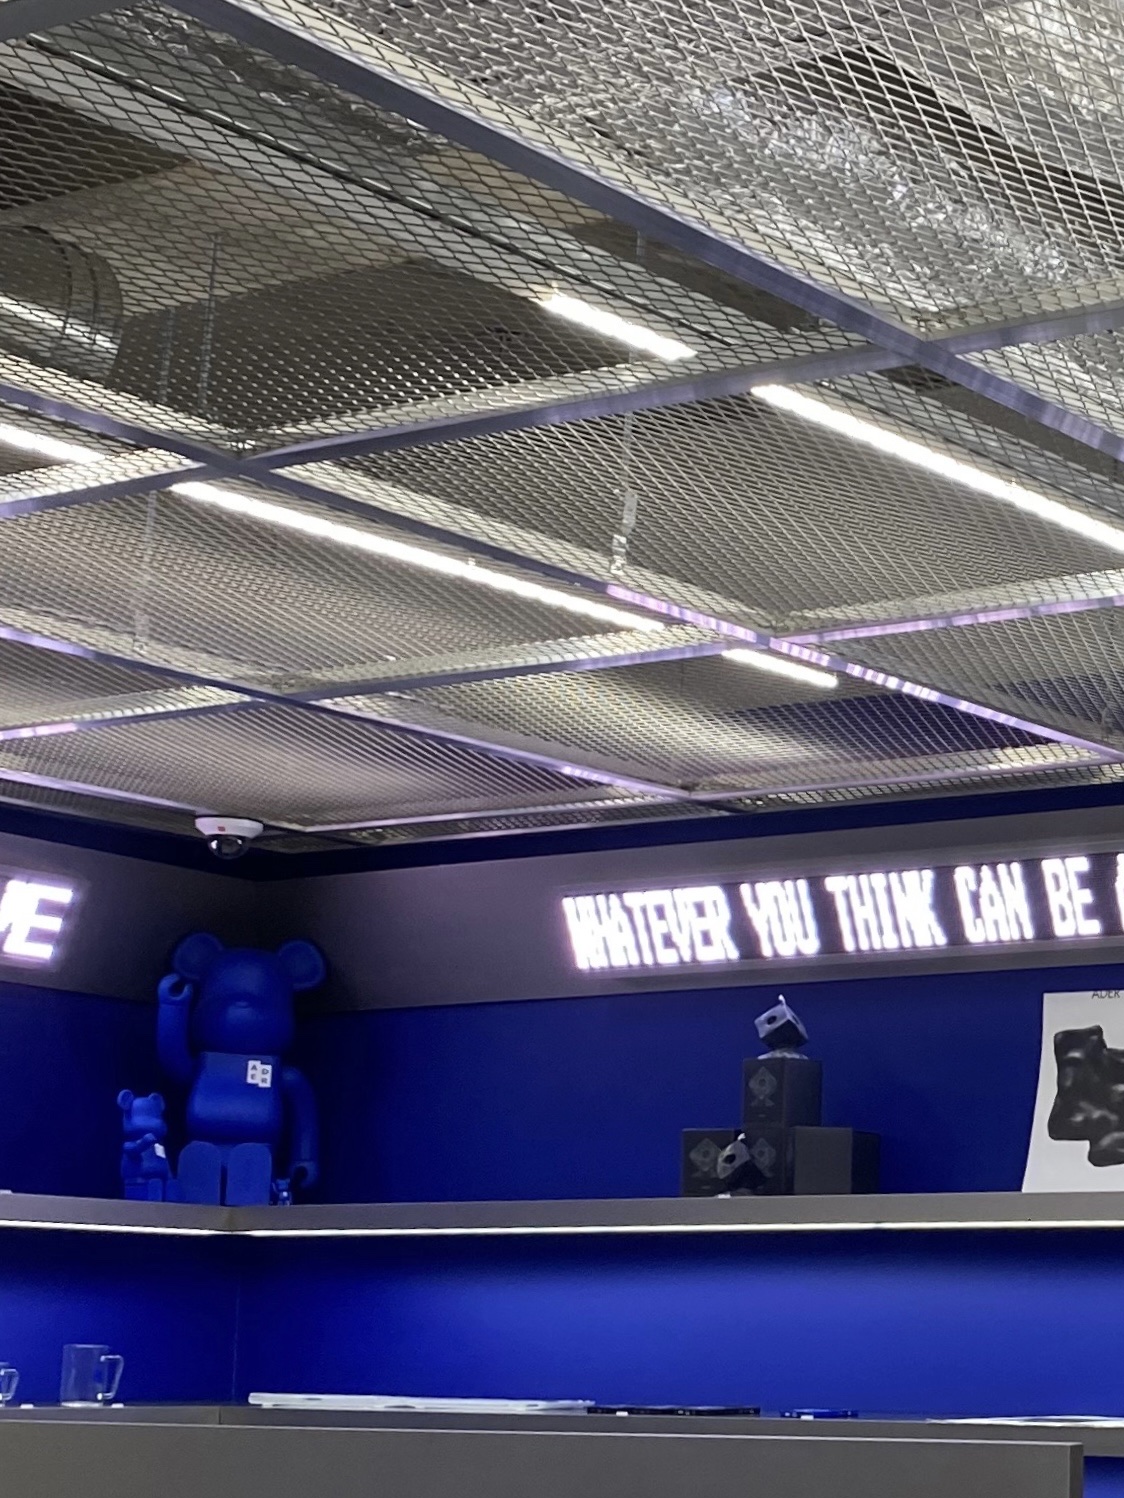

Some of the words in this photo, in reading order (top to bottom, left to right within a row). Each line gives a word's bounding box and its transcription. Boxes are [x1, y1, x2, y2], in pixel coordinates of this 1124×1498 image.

[562, 886, 740, 970] WHATEVER
[740, 879, 820, 957] YOU
[824, 869, 948, 952] THINK
[954, 861, 1035, 944] CAN
[1041, 856, 1101, 937] BE
